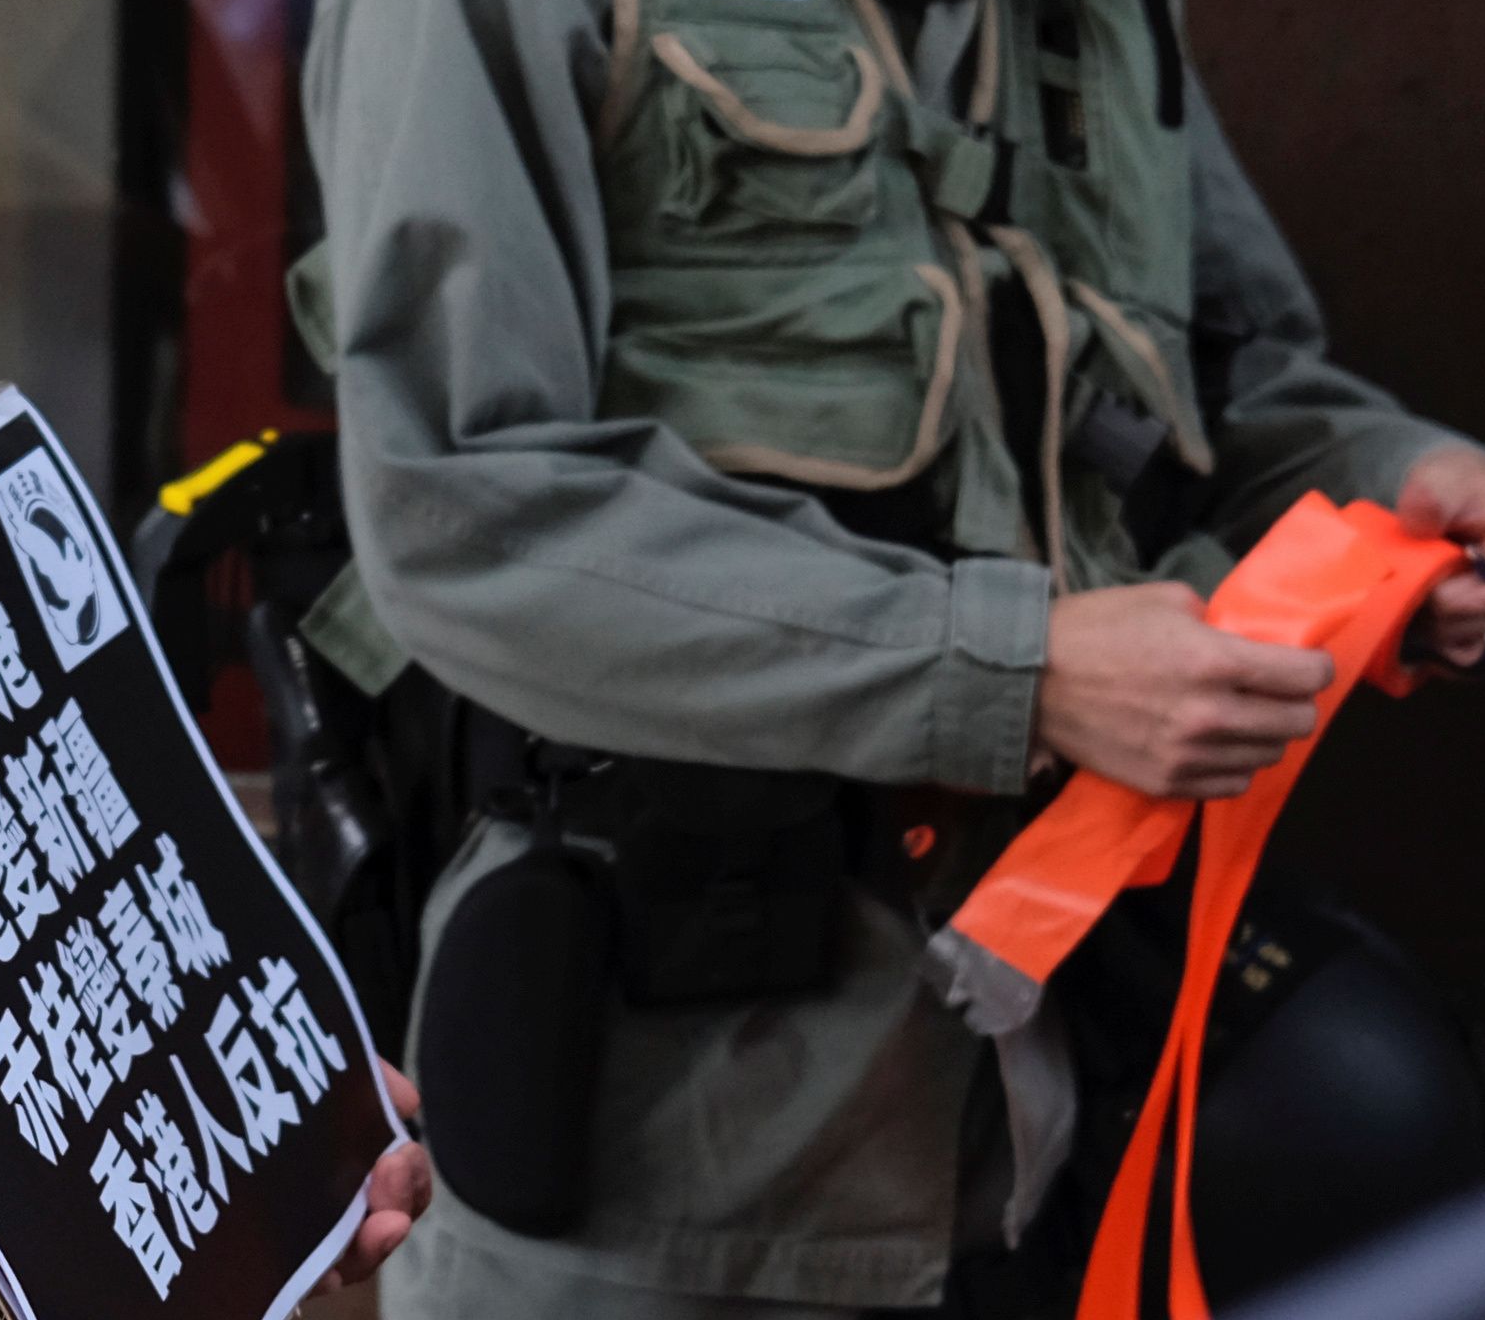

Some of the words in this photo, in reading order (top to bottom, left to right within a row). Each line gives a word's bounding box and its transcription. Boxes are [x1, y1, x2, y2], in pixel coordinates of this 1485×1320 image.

[90, 957, 346, 1301] 香港人反抗
